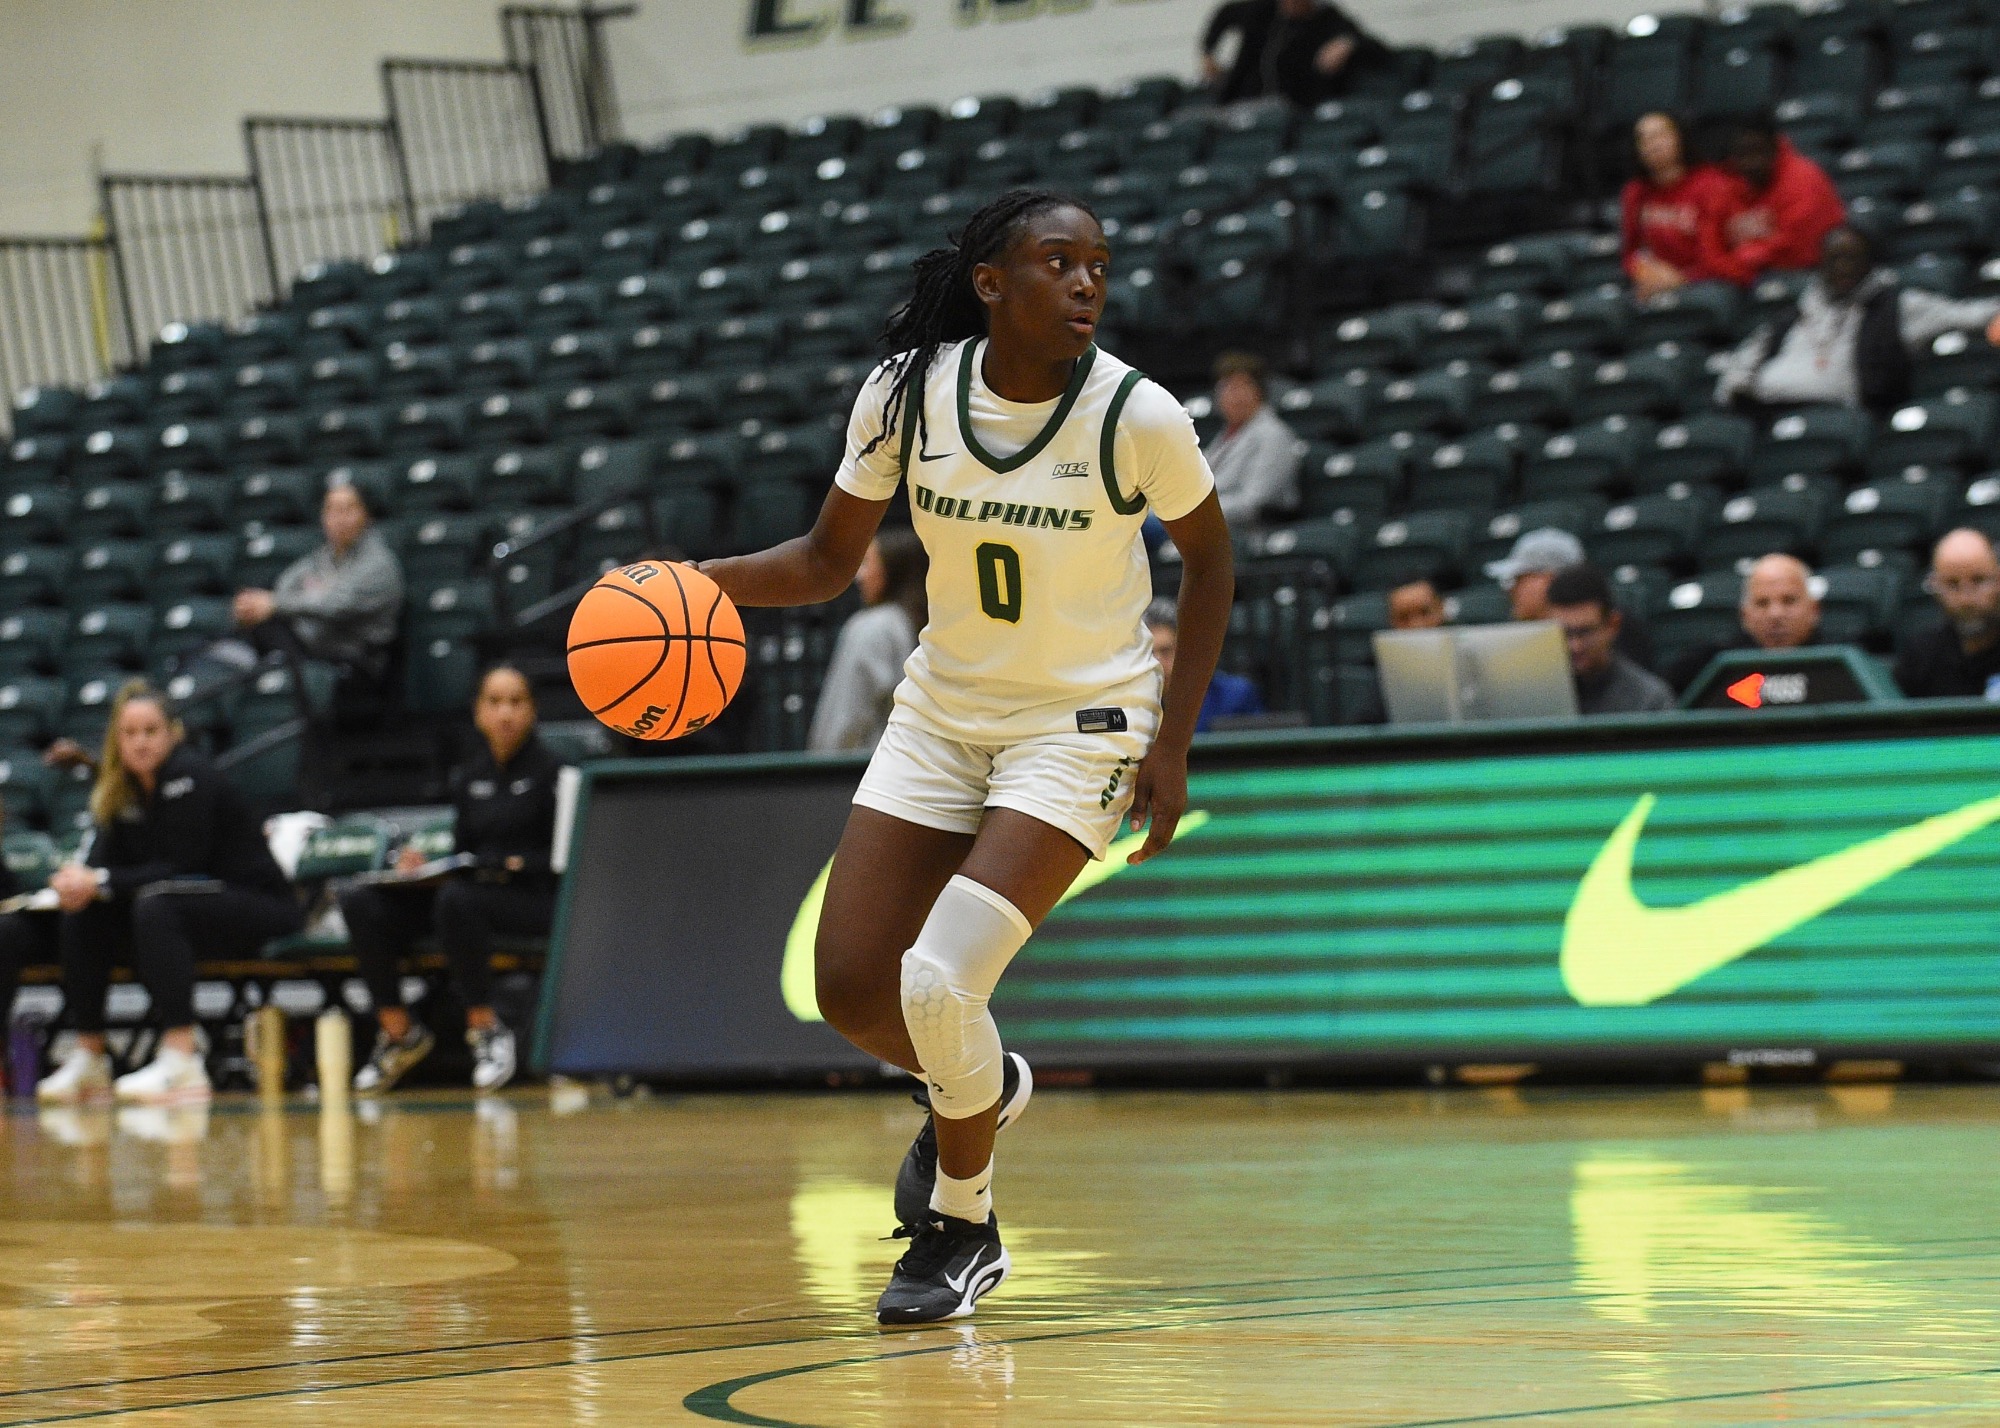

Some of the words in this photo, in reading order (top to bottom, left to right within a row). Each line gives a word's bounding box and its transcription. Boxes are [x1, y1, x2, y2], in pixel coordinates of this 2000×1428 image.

[1053, 462, 1089, 476] NEC
[915, 484, 1095, 531] DOLPHINS
[975, 540, 1023, 628] 0
[1112, 714, 1122, 725] M
